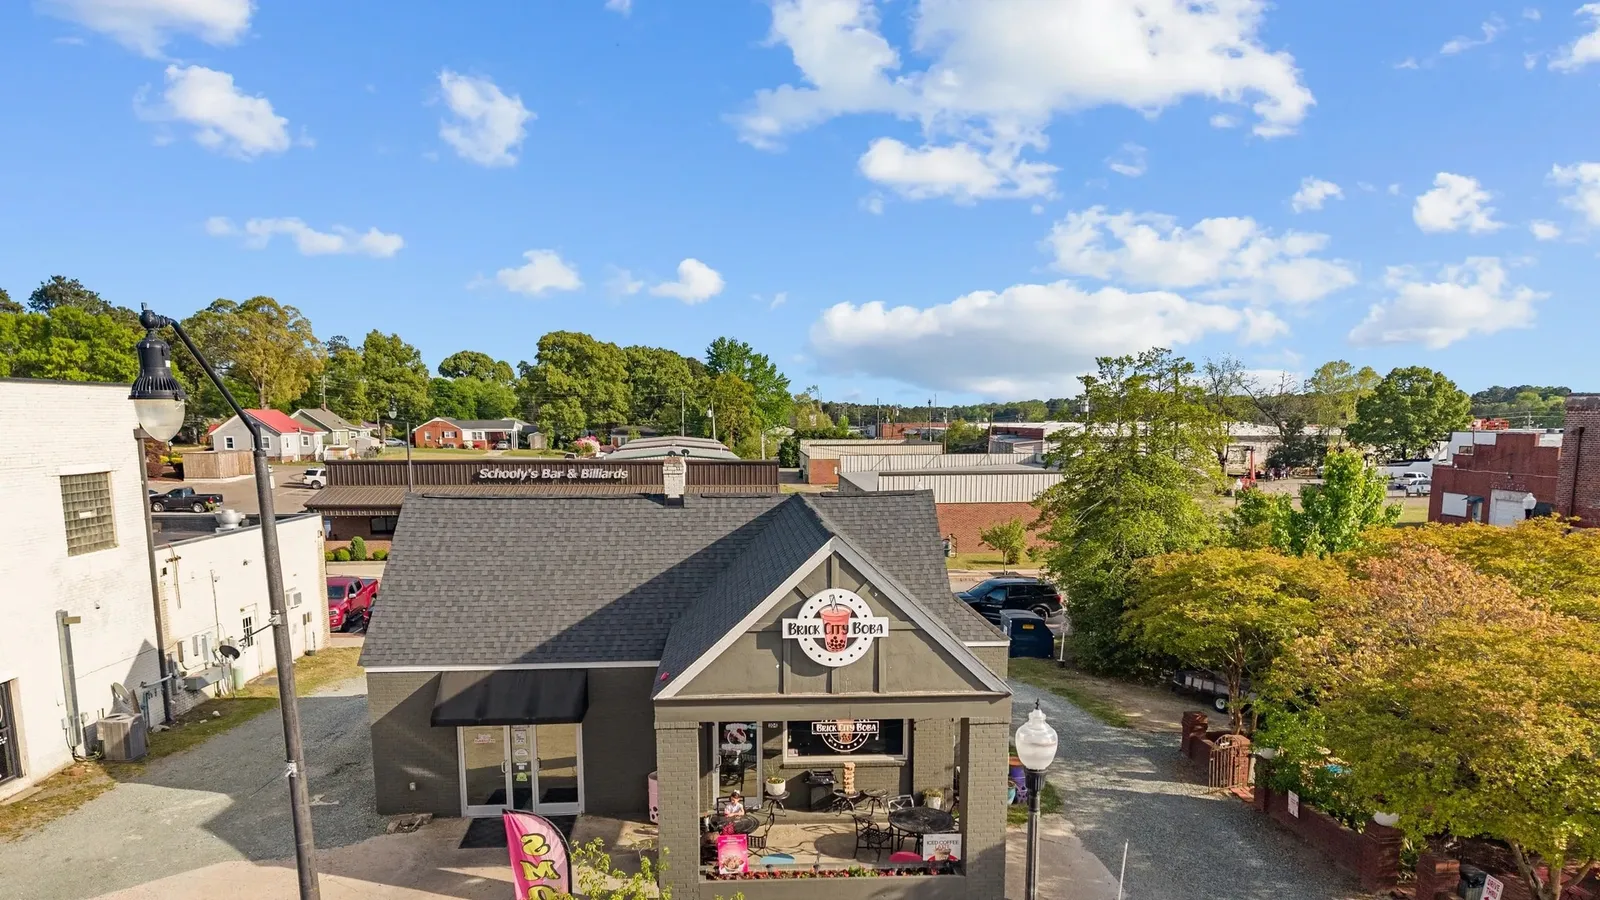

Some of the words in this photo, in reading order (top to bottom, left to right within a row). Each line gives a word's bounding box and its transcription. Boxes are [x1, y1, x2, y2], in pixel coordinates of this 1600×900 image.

[479, 468, 538, 481] Schooly's
[541, 468, 565, 479] Bar
[566, 468, 578, 479] &
[580, 468, 628, 479] Billiards
